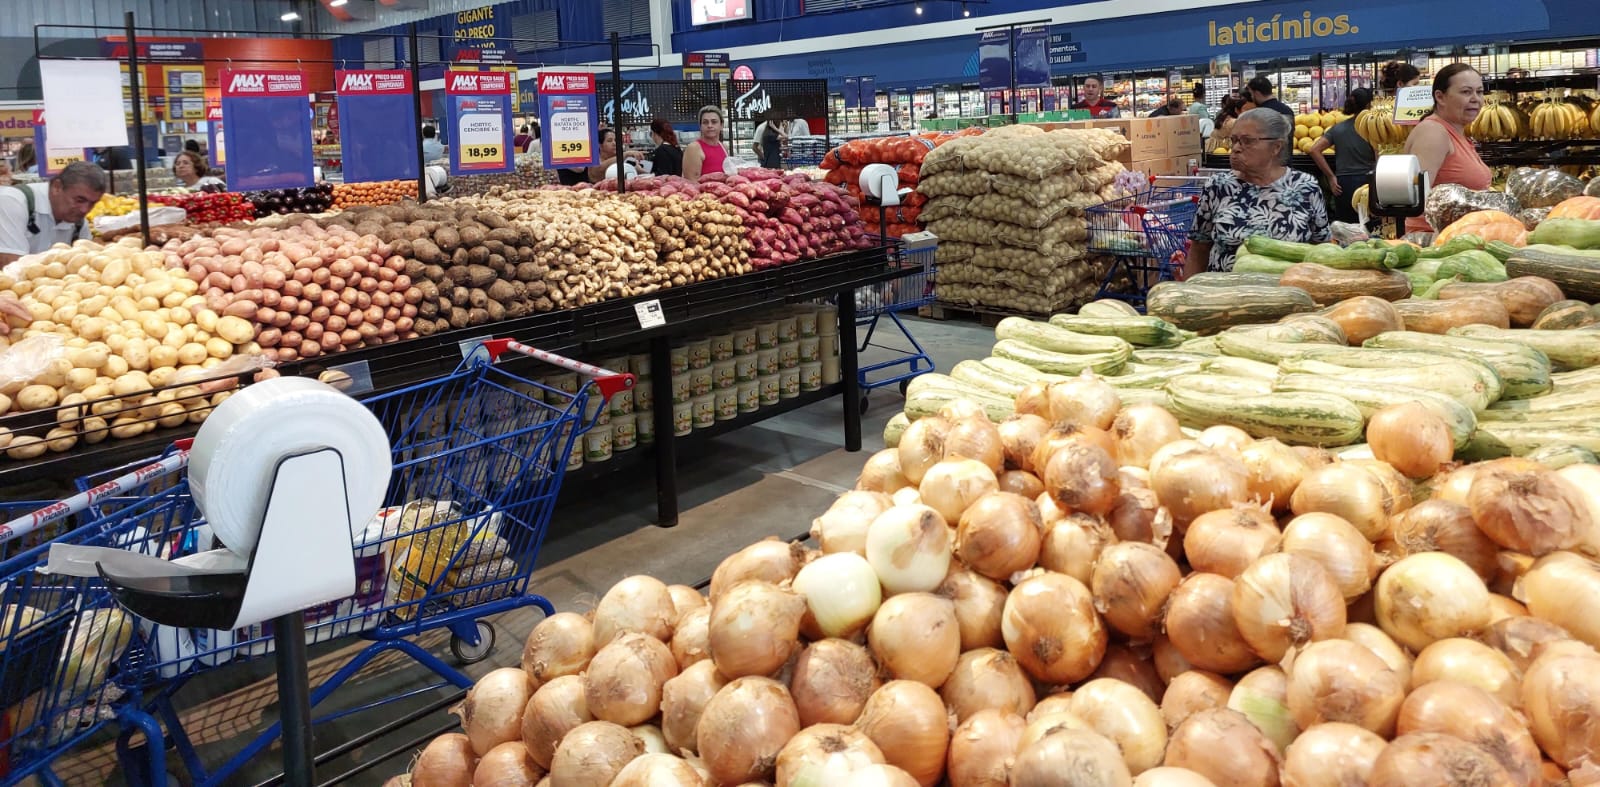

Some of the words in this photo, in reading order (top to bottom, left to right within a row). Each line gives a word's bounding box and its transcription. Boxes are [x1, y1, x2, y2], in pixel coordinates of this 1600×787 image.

[457, 6, 495, 25] GIGANTE
[1208, 10, 1360, 47] laticínios.
[228, 74, 265, 92] MAX
[341, 74, 373, 91] MAX
[451, 75, 478, 91] MAX
[541, 75, 565, 90] MAX
[734, 82, 772, 120] Fresh
[468, 147, 498, 158] 18,99
[561, 142, 583, 153] 5,99
